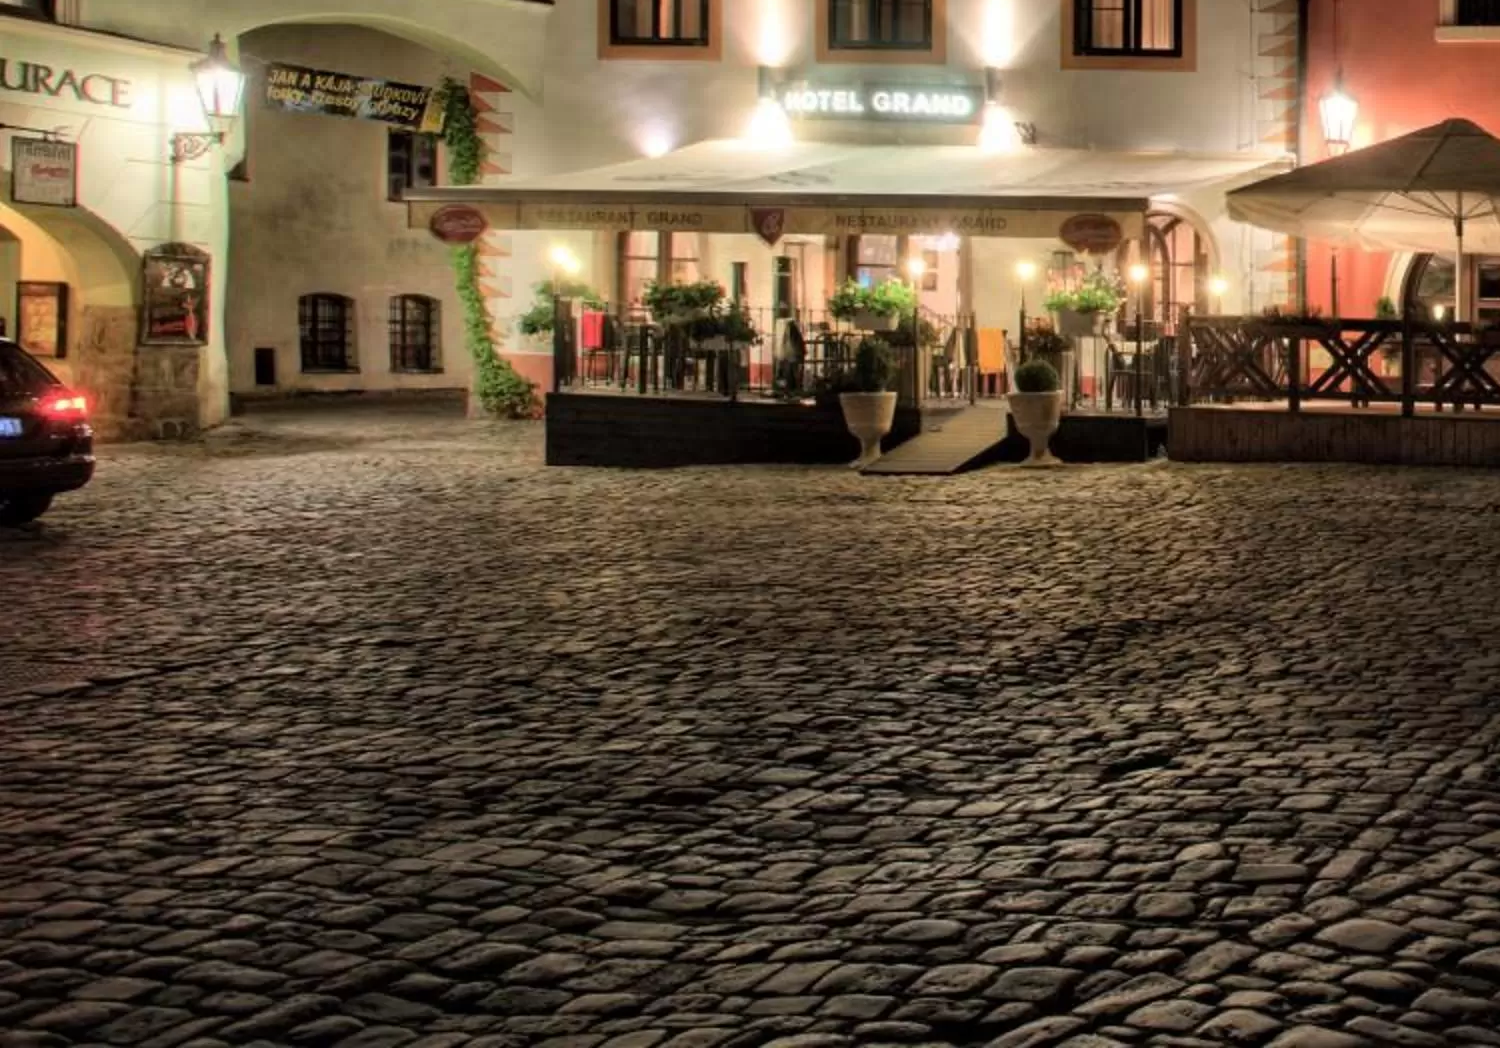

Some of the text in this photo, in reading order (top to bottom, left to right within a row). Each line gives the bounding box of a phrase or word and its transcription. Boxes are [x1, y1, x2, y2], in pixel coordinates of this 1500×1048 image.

[268, 69, 298, 86] JAN
[784, 90, 973, 115] HOTEL GRAND
[647, 211, 704, 226] GRAND
